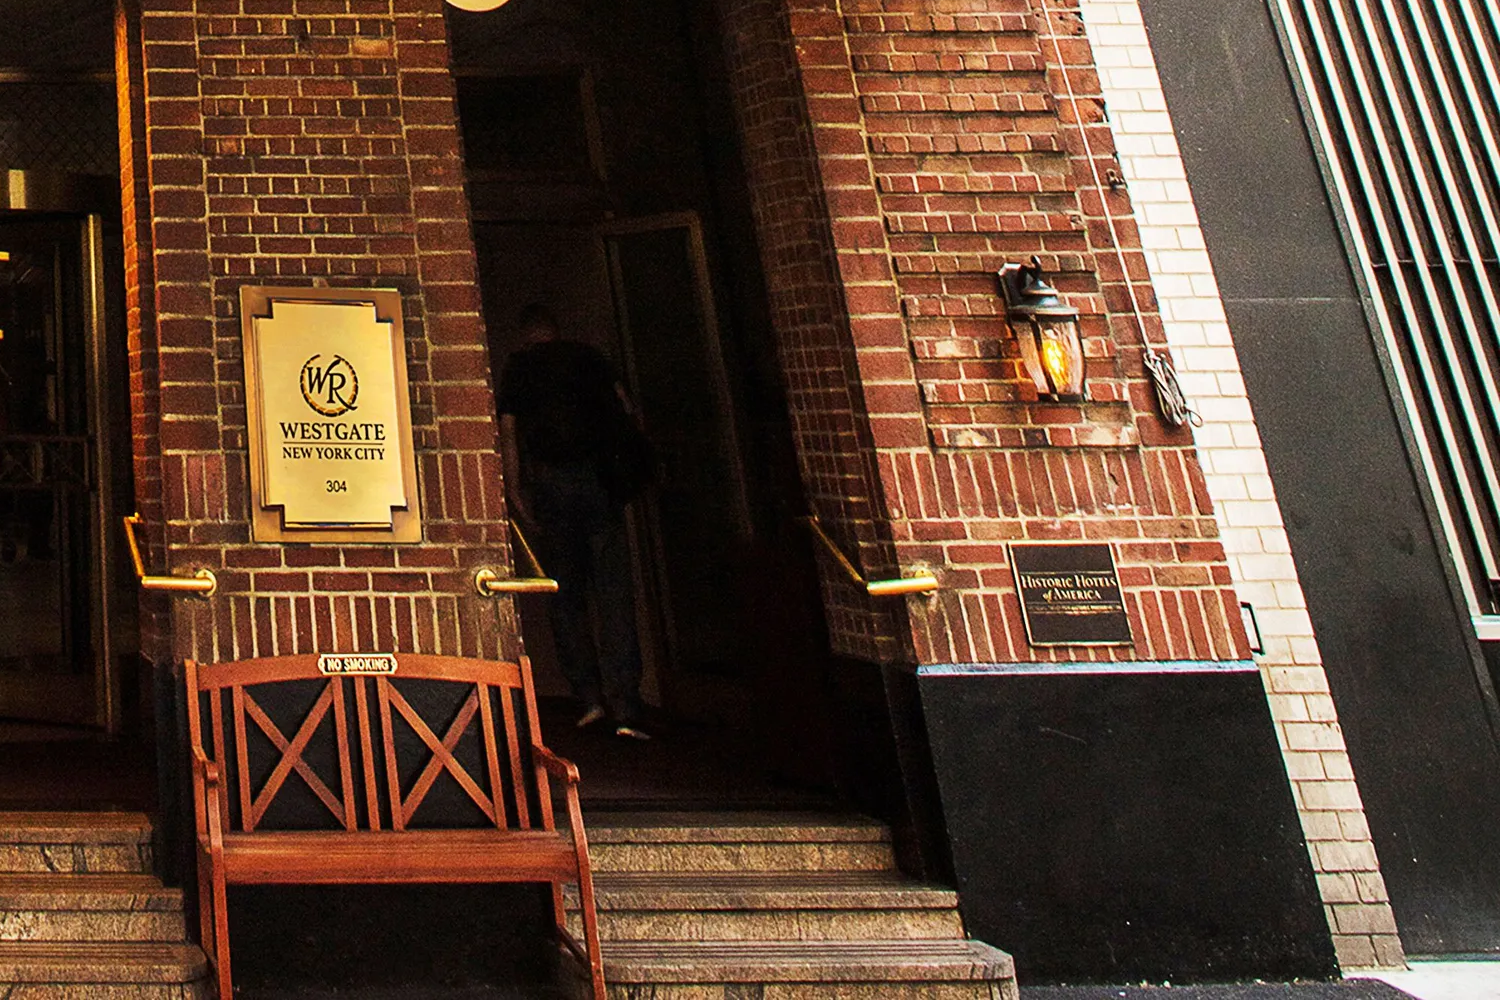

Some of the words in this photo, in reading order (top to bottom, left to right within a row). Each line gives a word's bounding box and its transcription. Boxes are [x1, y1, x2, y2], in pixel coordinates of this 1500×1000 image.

[279, 422, 386, 441] WESTGATE
[282, 446, 316, 460] NEW
[317, 447, 354, 460] YORK
[355, 447, 386, 461] CITY
[326, 479, 347, 493] 304
[327, 658, 342, 671] NO
[344, 658, 389, 672] SMOKING
